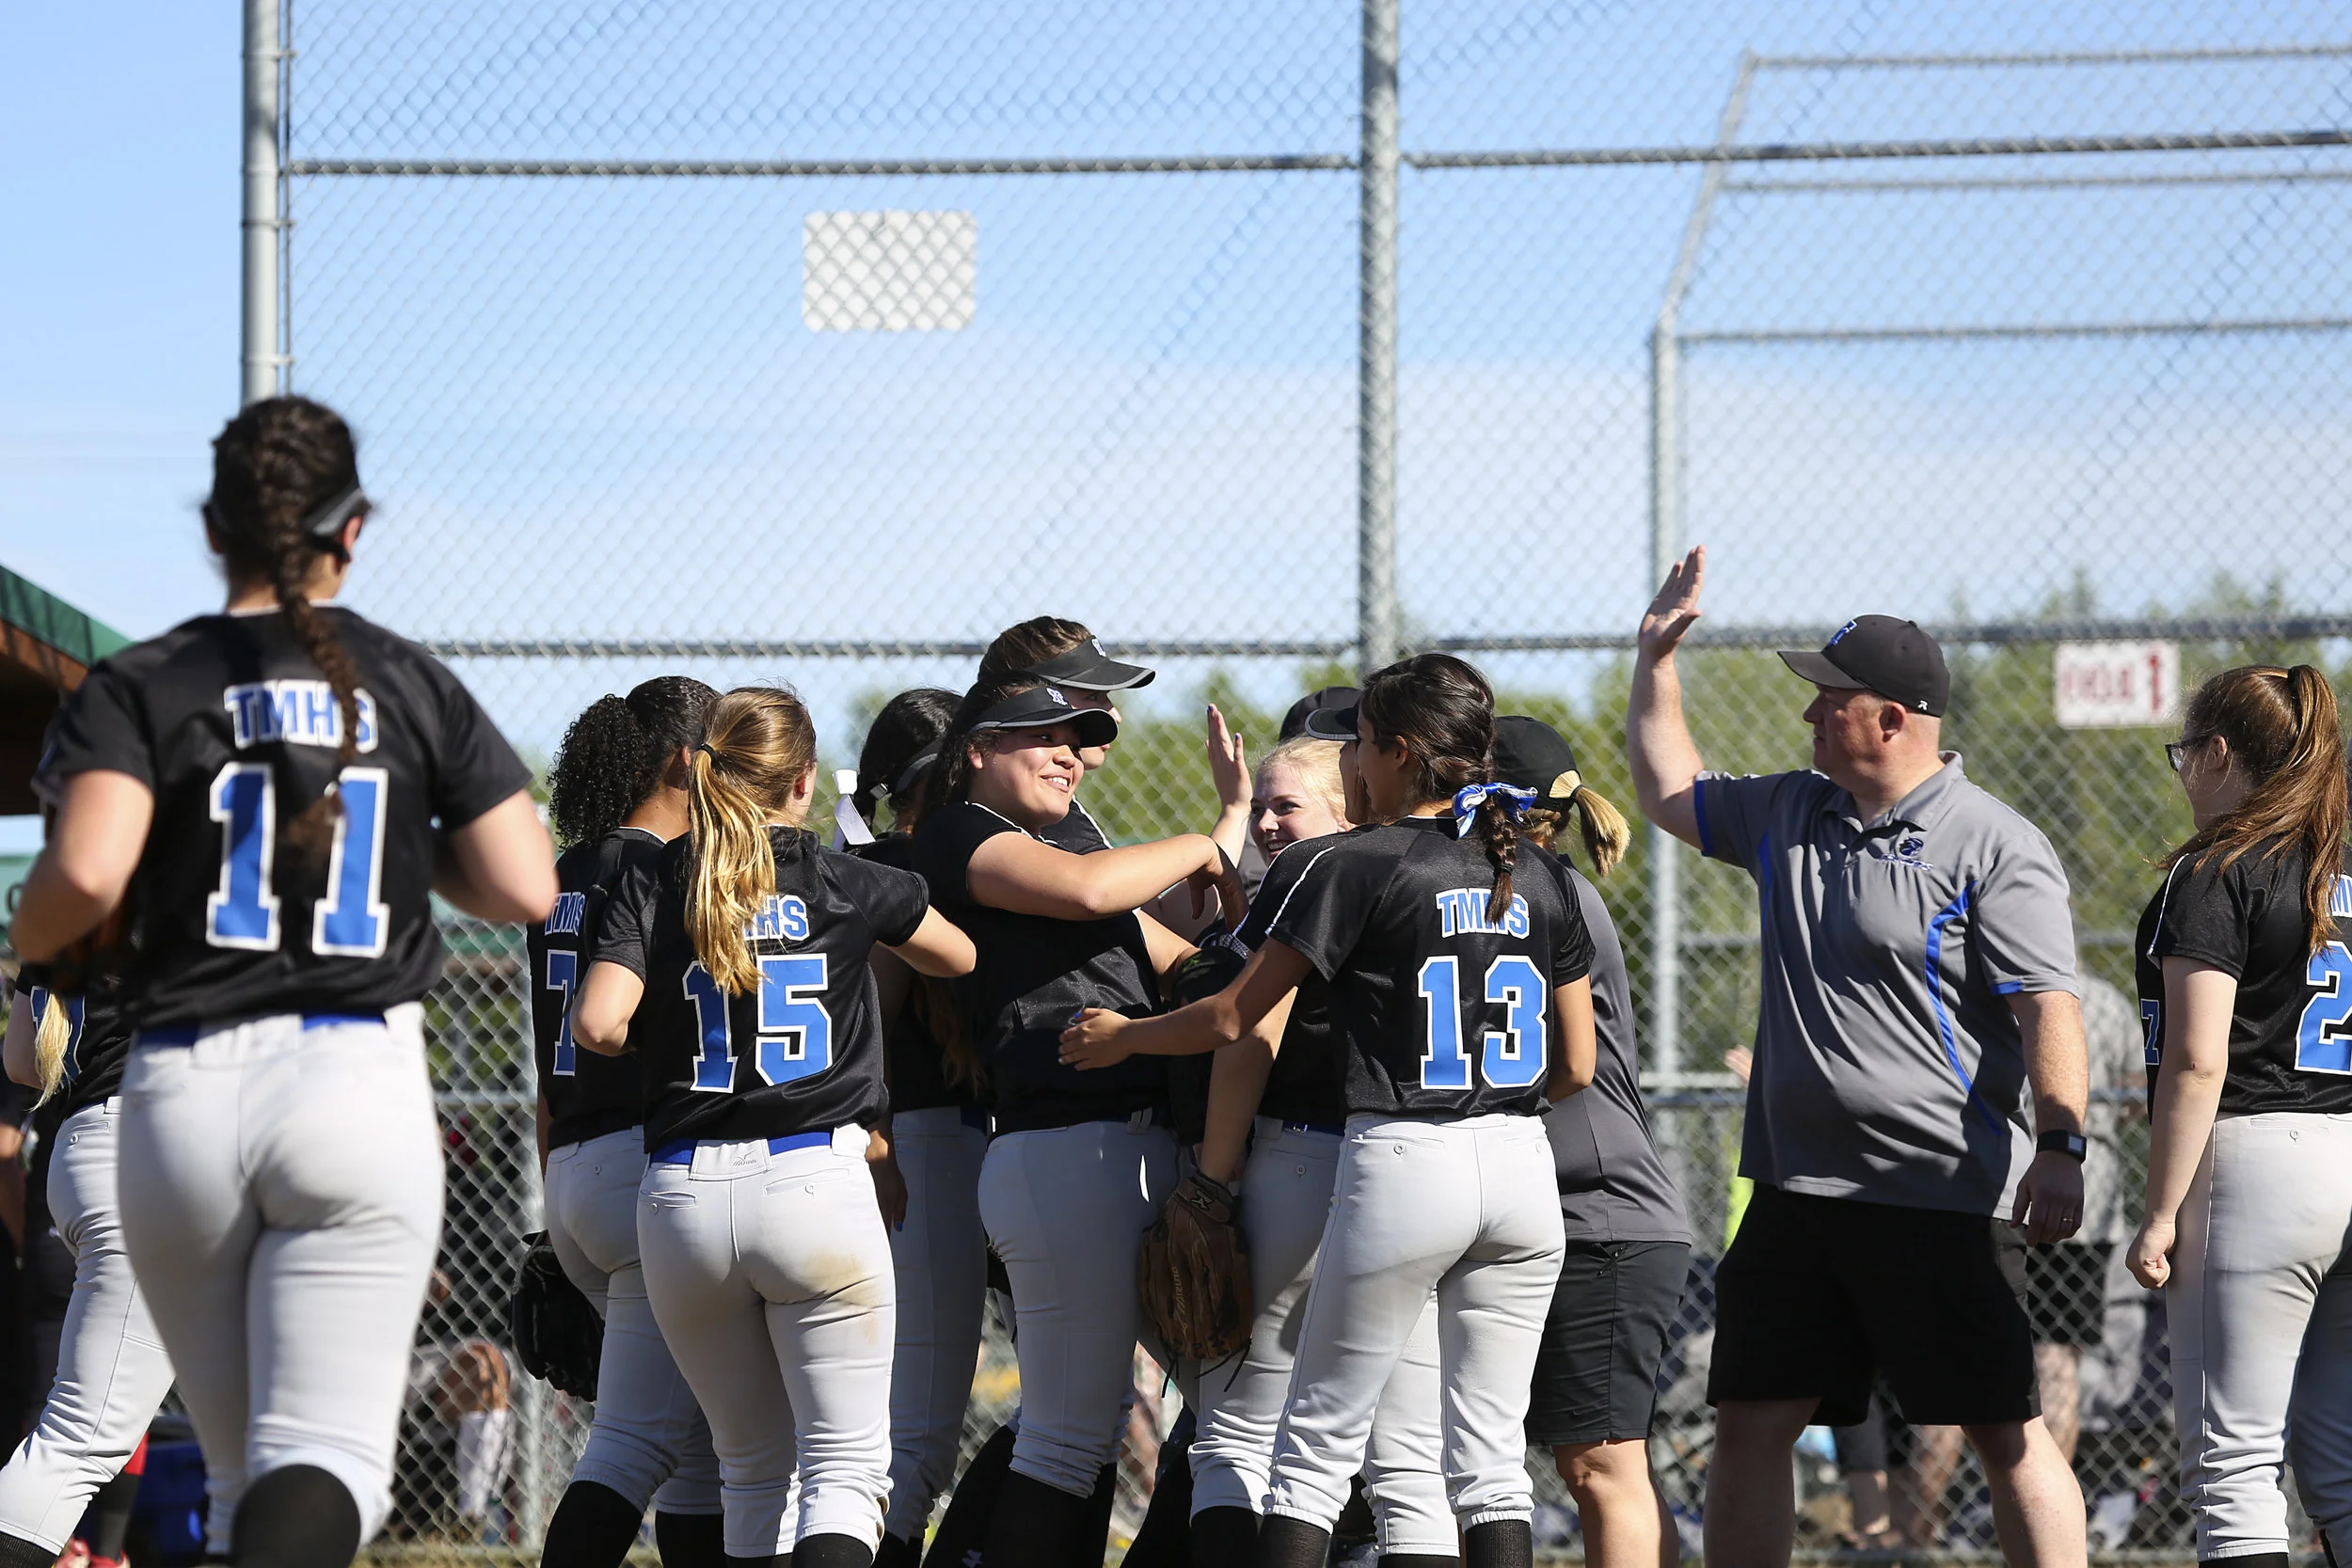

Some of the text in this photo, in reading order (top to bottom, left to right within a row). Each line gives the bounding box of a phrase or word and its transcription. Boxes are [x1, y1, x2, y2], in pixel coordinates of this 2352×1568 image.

[206, 762, 389, 958] 11
[742, 895, 810, 942] HS
[546, 949, 578, 1076] 7
[682, 953, 833, 1094] 15
[1418, 955, 1547, 1090] 13
